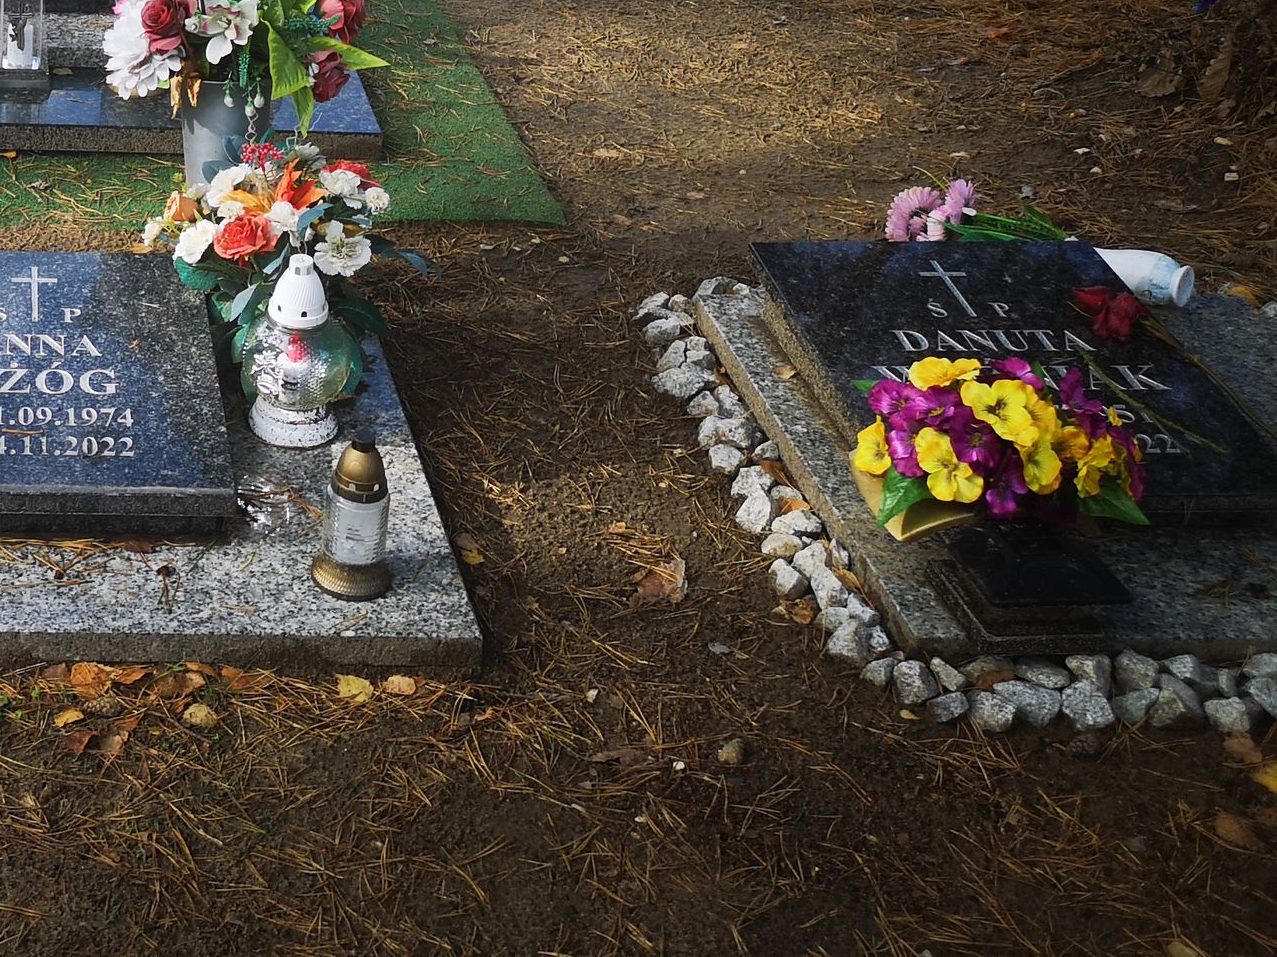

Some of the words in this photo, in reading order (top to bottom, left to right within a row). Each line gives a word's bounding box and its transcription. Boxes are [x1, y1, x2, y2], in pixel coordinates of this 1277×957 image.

[64, 308, 82, 323] P
[988, 302, 1011, 318] P
[890, 329, 1097, 353] DANUTA
